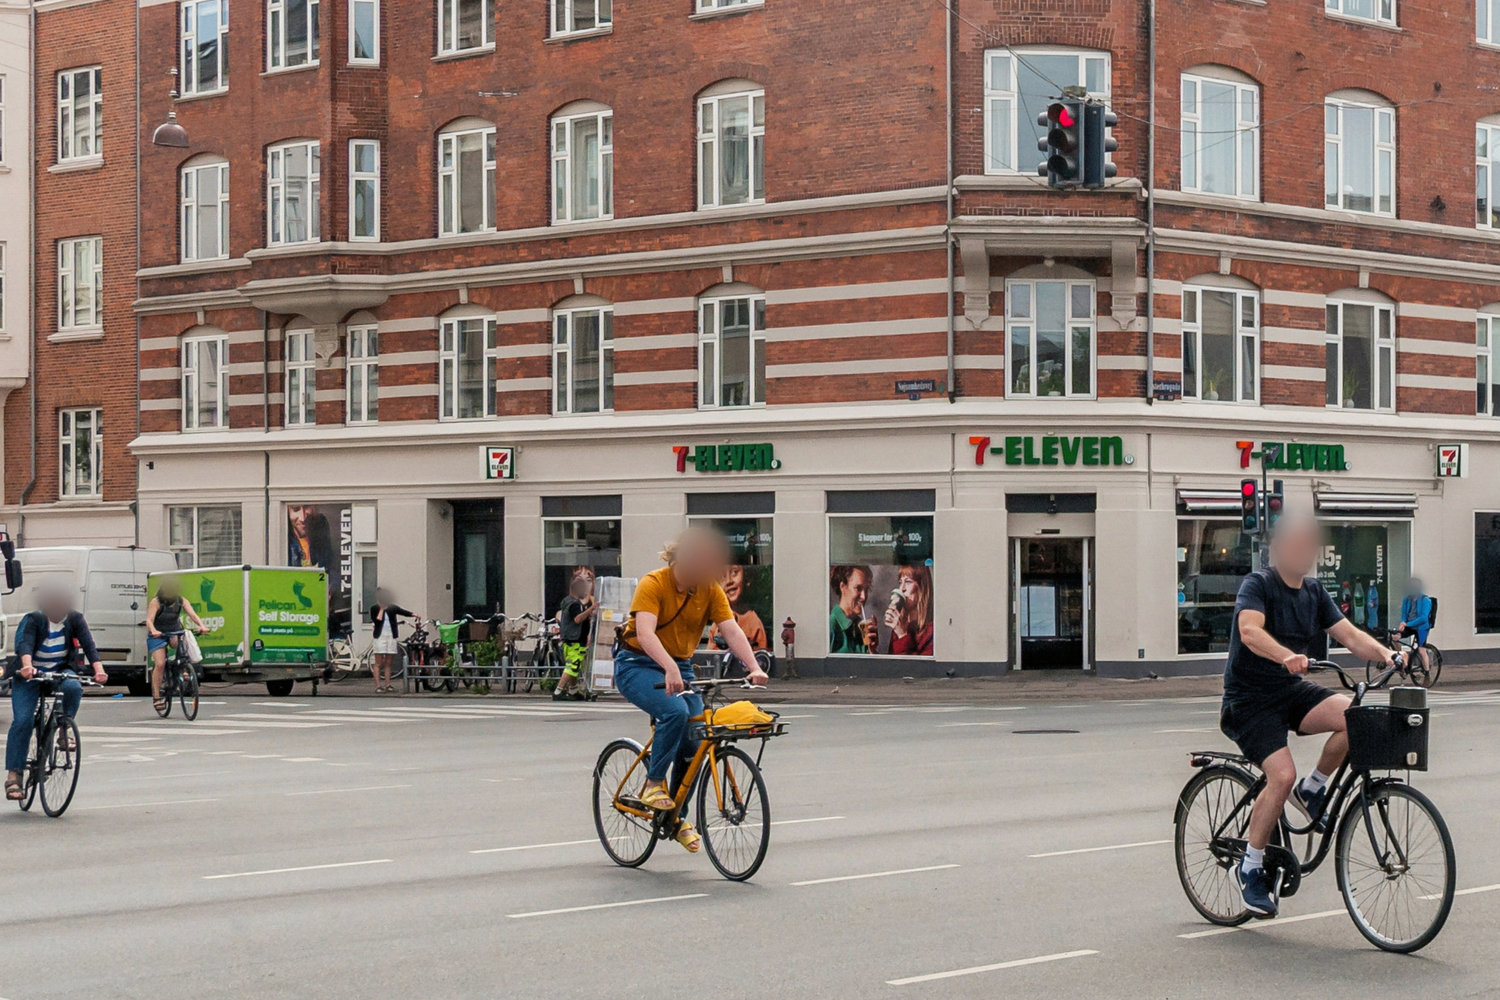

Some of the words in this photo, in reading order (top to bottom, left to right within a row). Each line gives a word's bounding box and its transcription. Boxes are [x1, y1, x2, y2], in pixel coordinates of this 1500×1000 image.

[318, 573, 325, 582] 2
[258, 599, 297, 611] Pelican
[258, 611, 278, 622] Self
[279, 612, 320, 625] Storage
